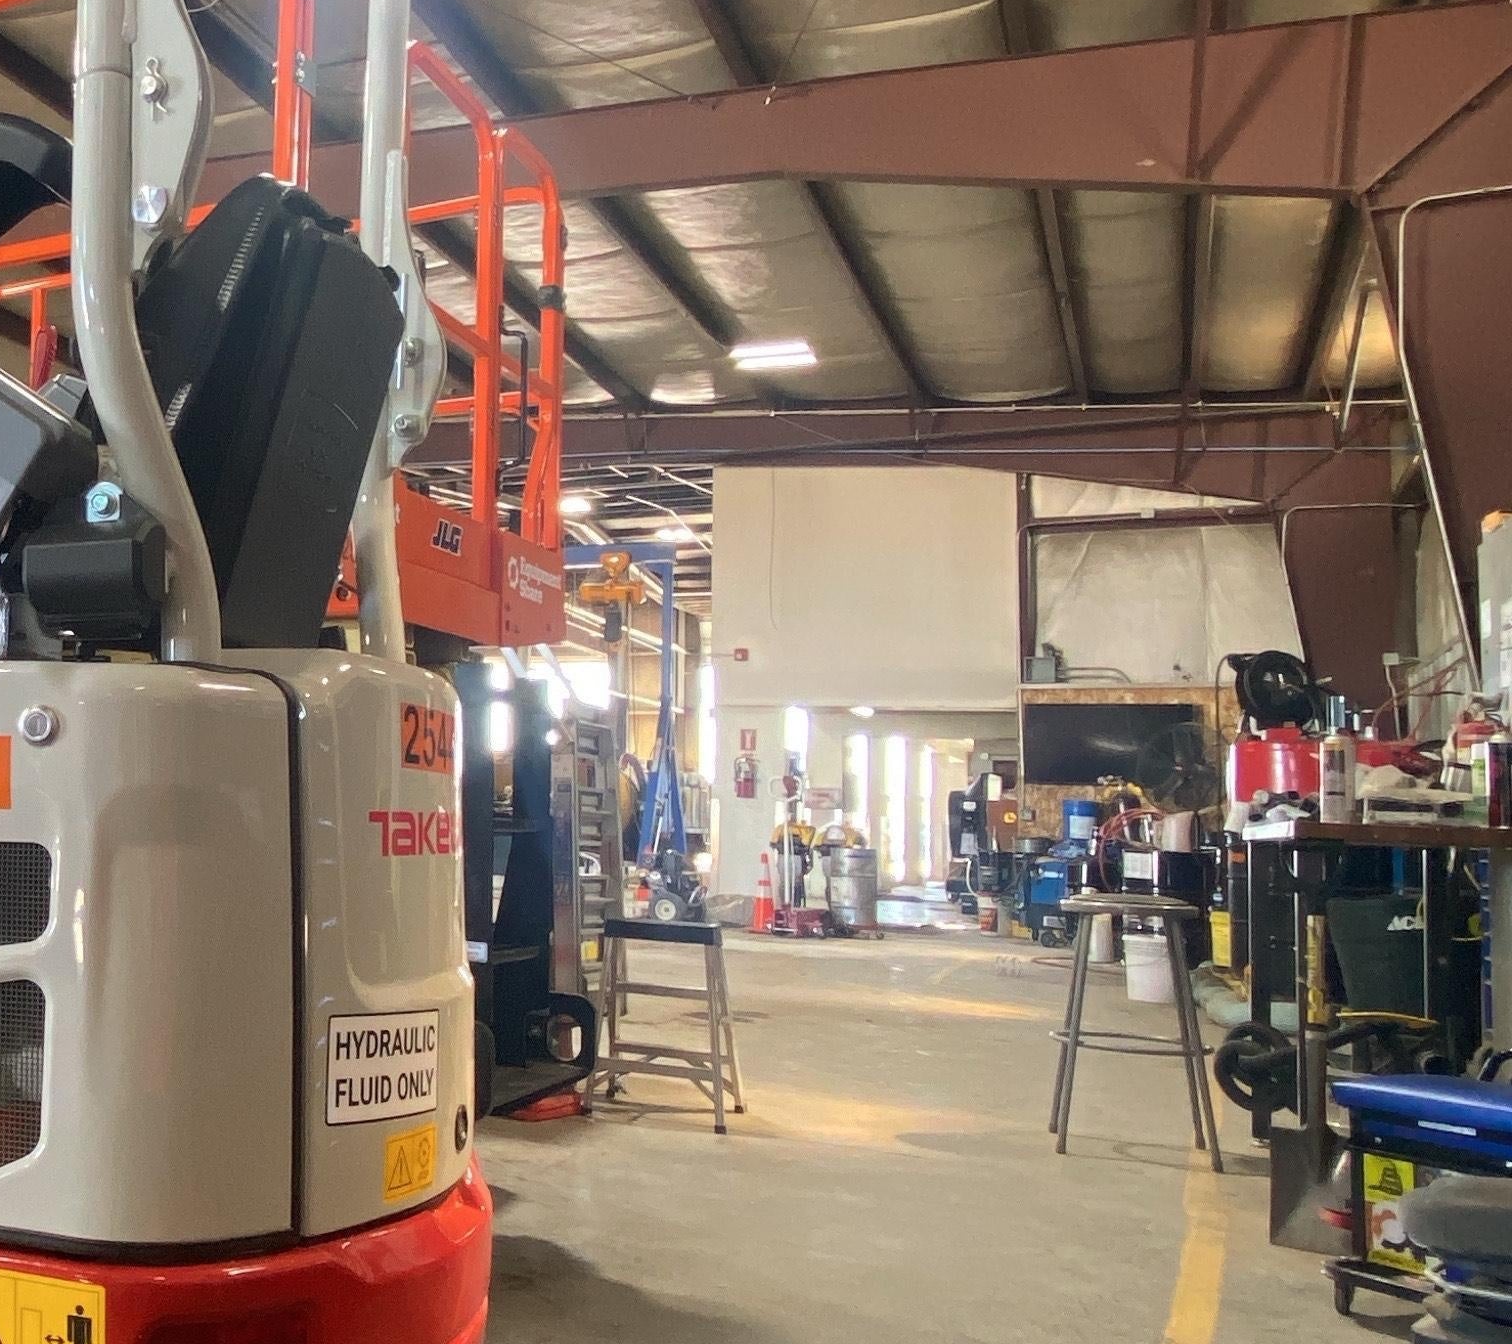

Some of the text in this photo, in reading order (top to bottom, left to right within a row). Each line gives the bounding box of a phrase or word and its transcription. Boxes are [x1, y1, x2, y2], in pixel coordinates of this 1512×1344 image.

[431, 518, 464, 556] JLG
[404, 704, 455, 770] 254
[335, 1025, 436, 1061] HYDRAULIC
[335, 1068, 434, 1108] FLUID ONLY
